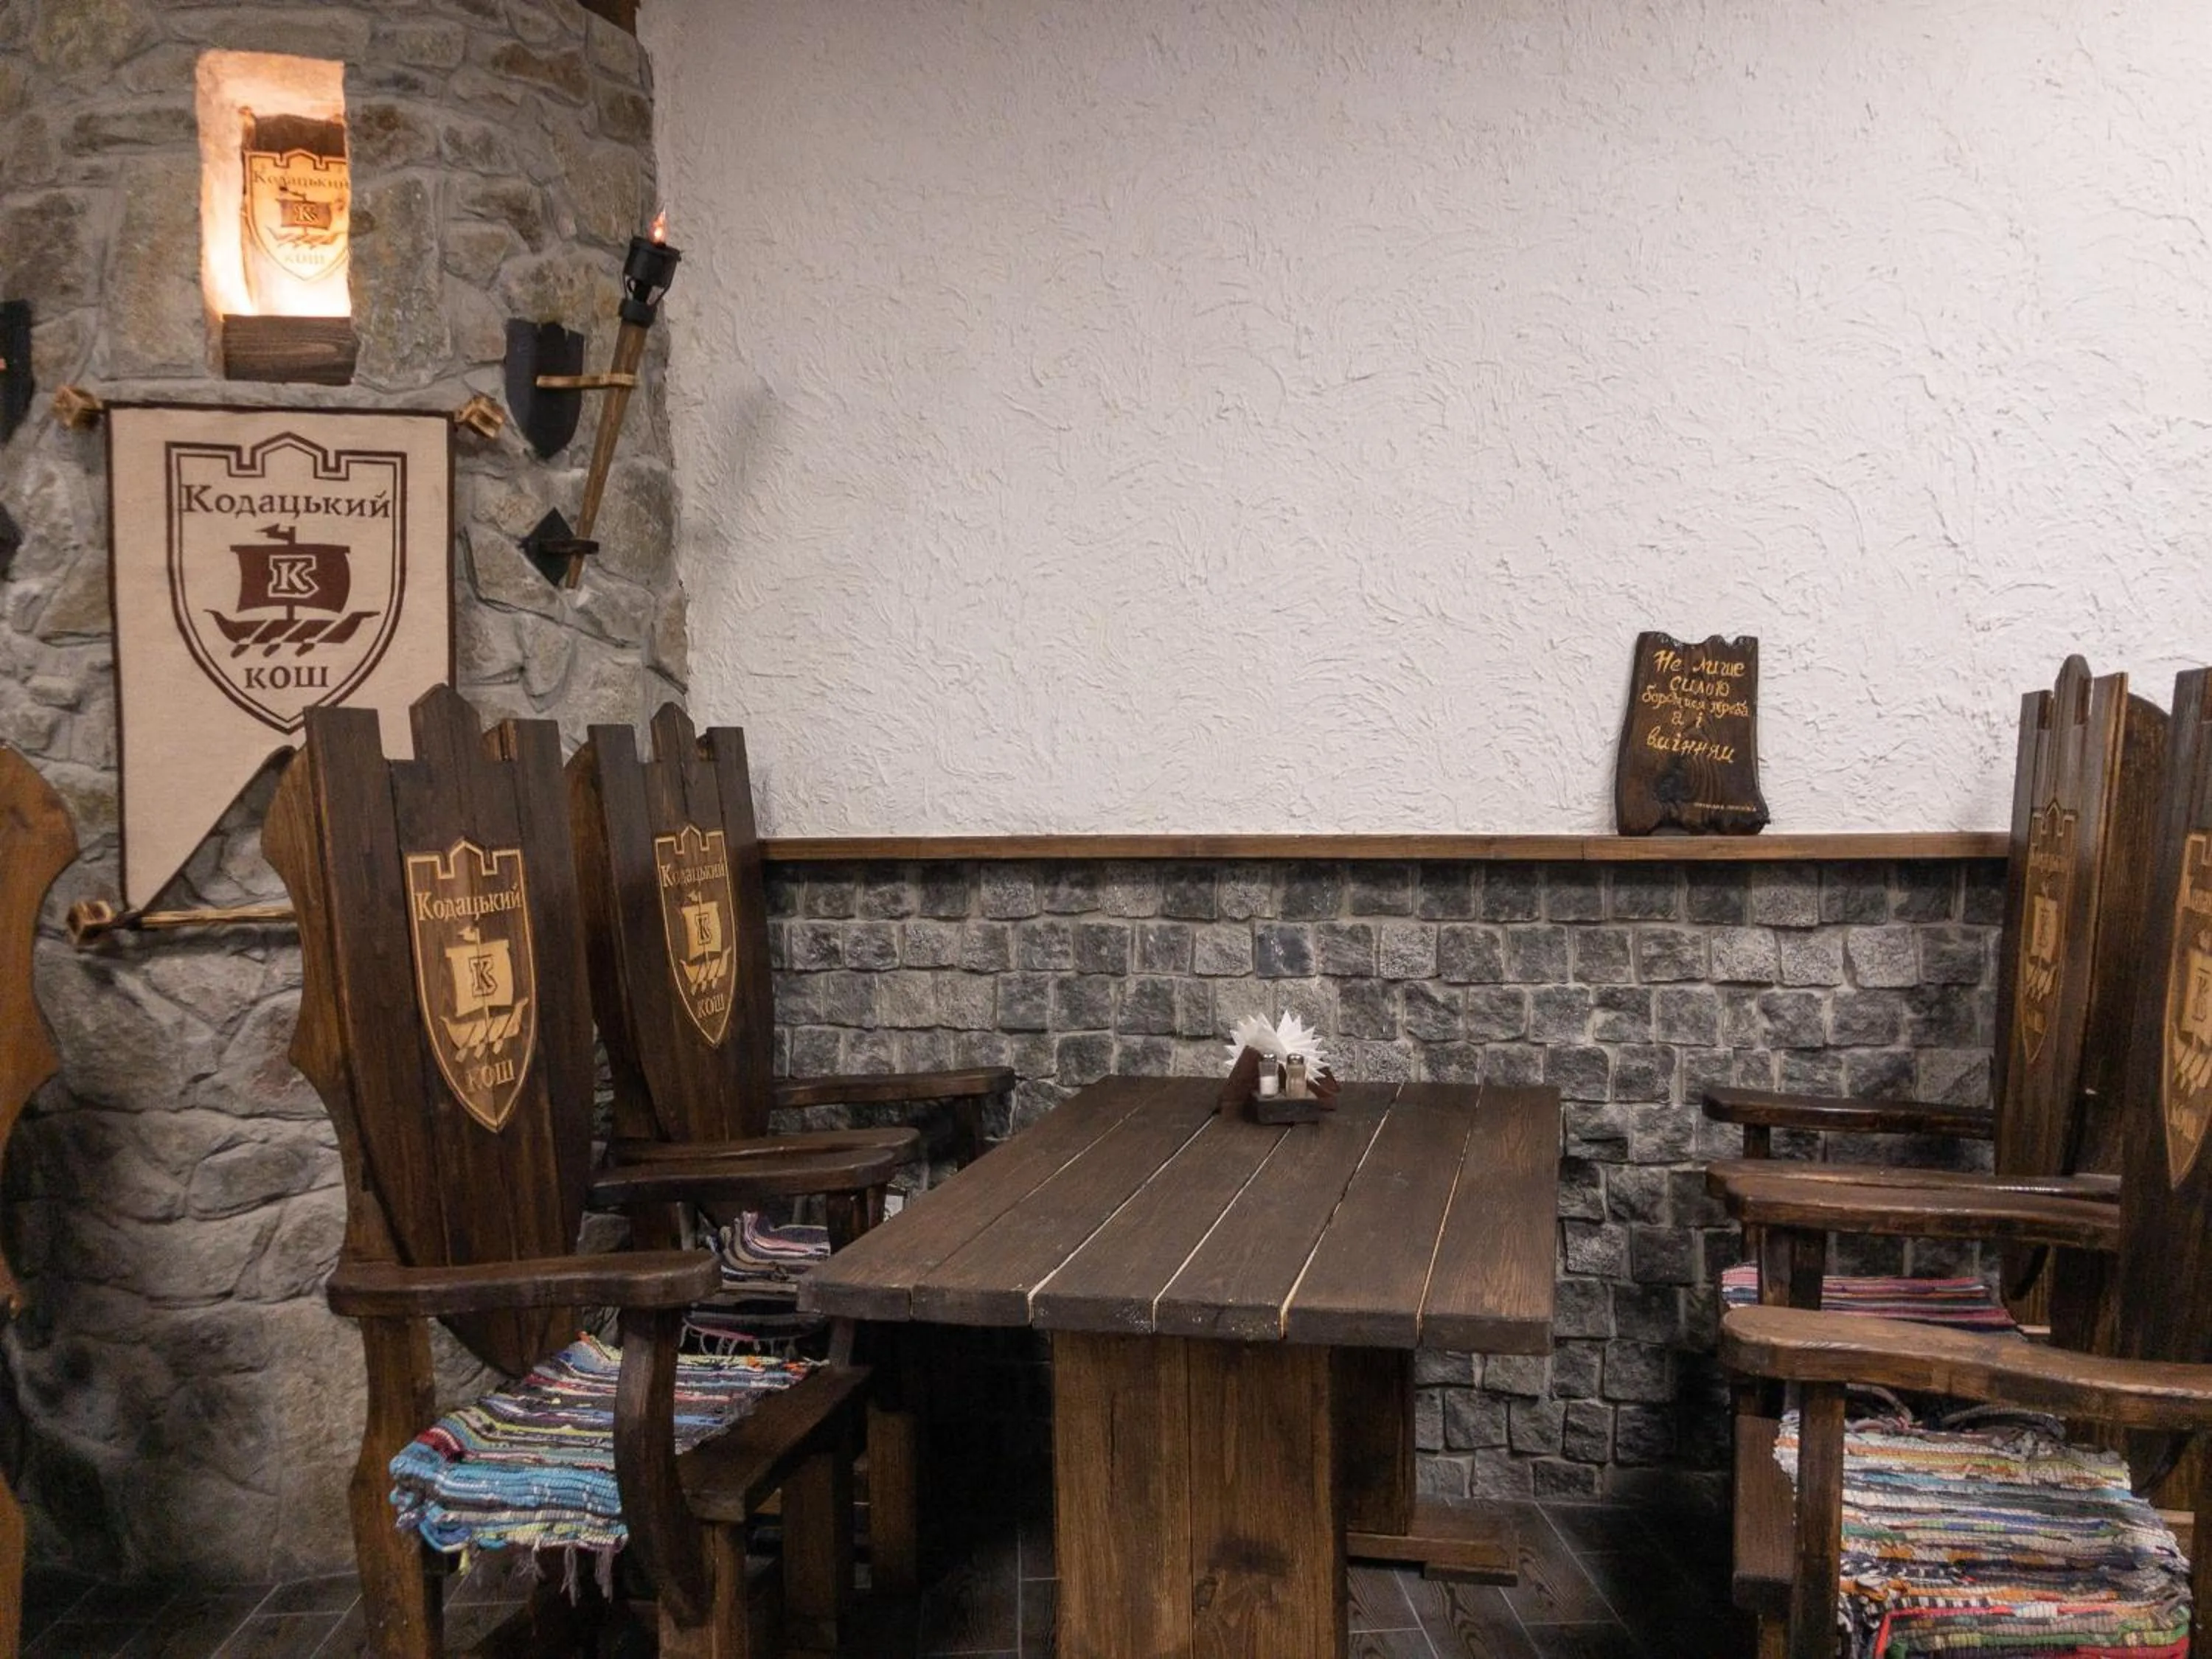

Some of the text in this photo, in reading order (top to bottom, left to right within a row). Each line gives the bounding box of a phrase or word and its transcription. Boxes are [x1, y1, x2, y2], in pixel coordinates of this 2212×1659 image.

[182, 484, 391, 518] Кодацький
[1653, 649, 1745, 678] Не лише
[244, 665, 330, 689] кош
[1669, 676, 1730, 698] силою
[1672, 710, 1703, 729] а і
[414, 883, 522, 922] Кодацький
